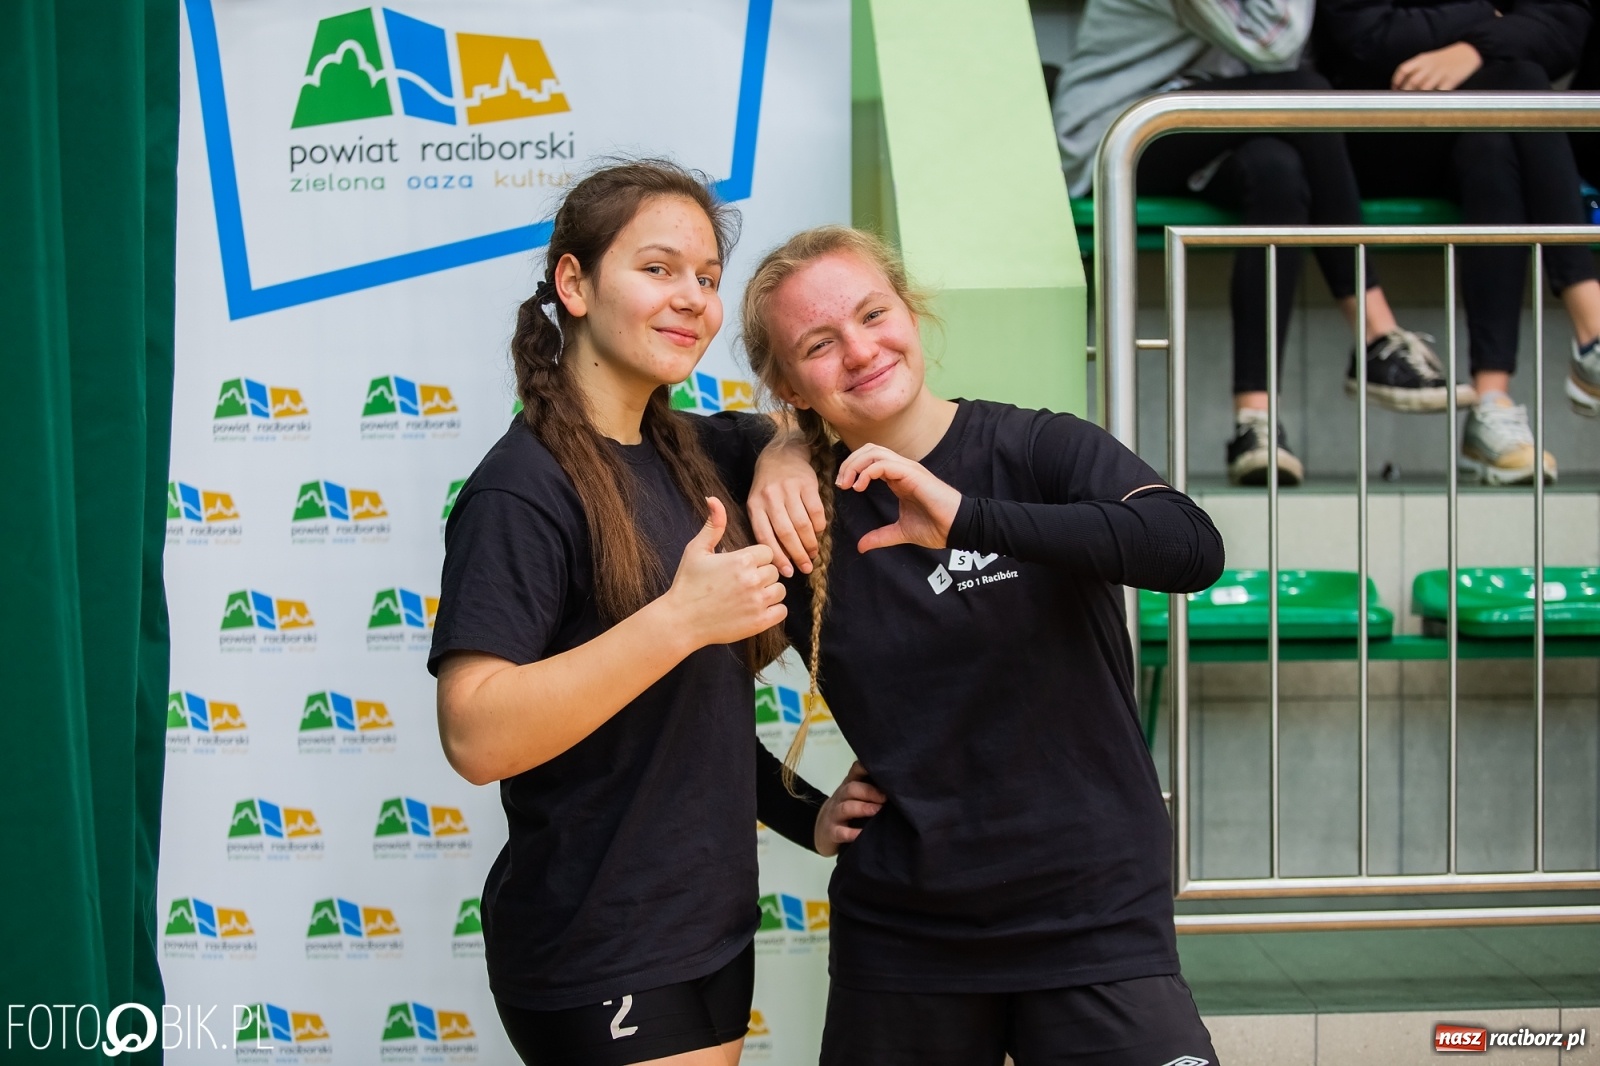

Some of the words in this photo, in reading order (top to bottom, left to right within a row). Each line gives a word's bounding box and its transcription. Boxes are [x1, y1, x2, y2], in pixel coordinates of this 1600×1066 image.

[290, 135, 399, 173] powiat
[420, 131, 575, 162] raciborski
[290, 173, 385, 192] zielona
[407, 174, 474, 190] oaza
[956, 579, 975, 592] ZSO
[982, 569, 1019, 585] Racibórz
